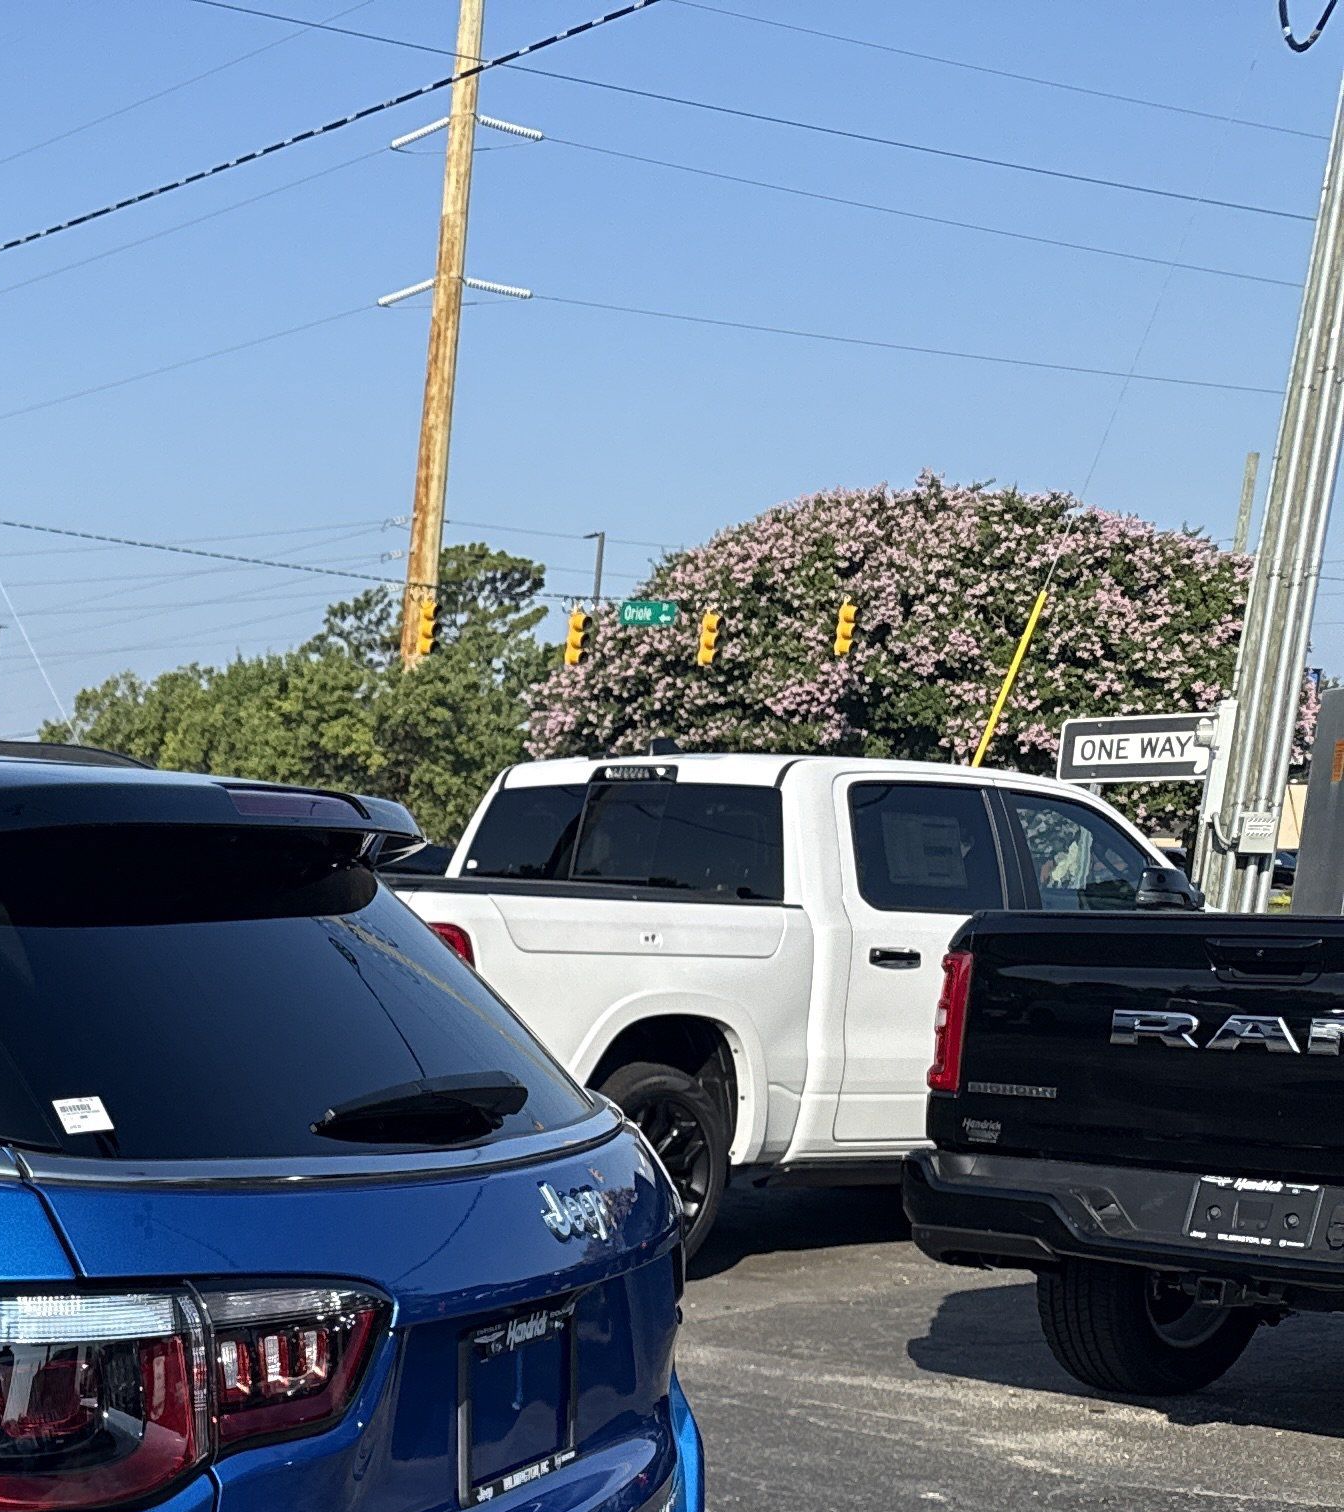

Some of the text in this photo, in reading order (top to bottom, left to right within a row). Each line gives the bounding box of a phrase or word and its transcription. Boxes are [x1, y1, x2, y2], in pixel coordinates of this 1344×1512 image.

[624, 604, 652, 621] Oriole
[1080, 735, 1193, 761] ONE WAY
[538, 1182, 608, 1241] Jeep
